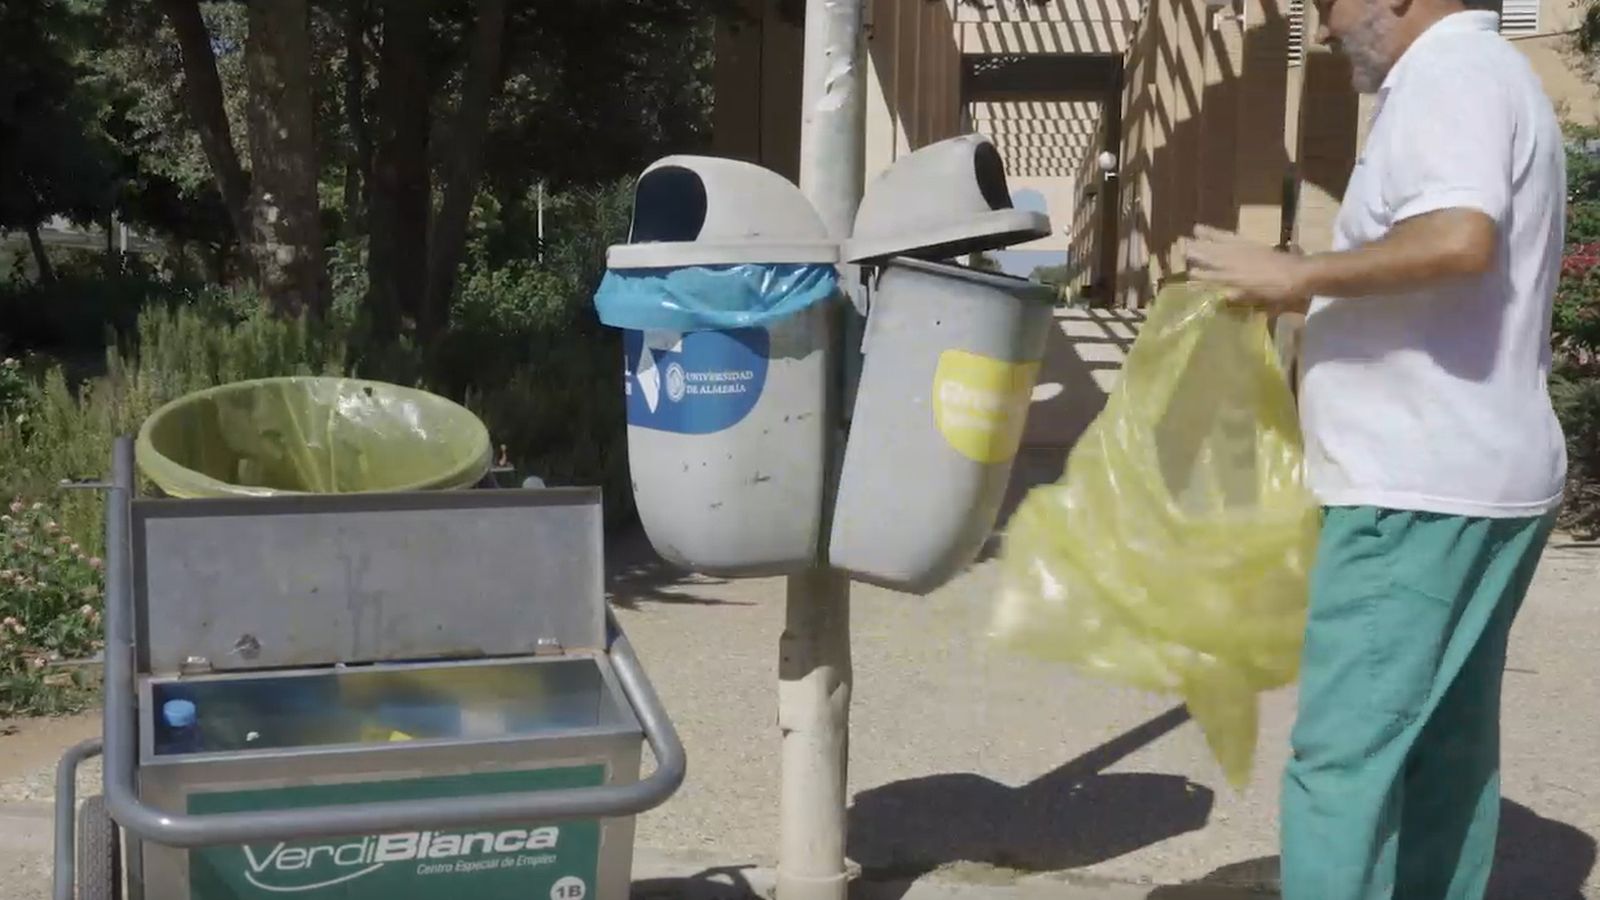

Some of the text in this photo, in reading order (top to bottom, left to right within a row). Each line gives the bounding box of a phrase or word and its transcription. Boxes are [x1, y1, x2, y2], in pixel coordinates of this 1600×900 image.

[685, 370, 754, 382] UNIVERSIDAD
[686, 384, 699, 395] DE
[243, 826, 560, 872] VerdiBlanca
[416, 854, 557, 875] Centro Especial de Empleo
[555, 884, 582, 899] 1B
